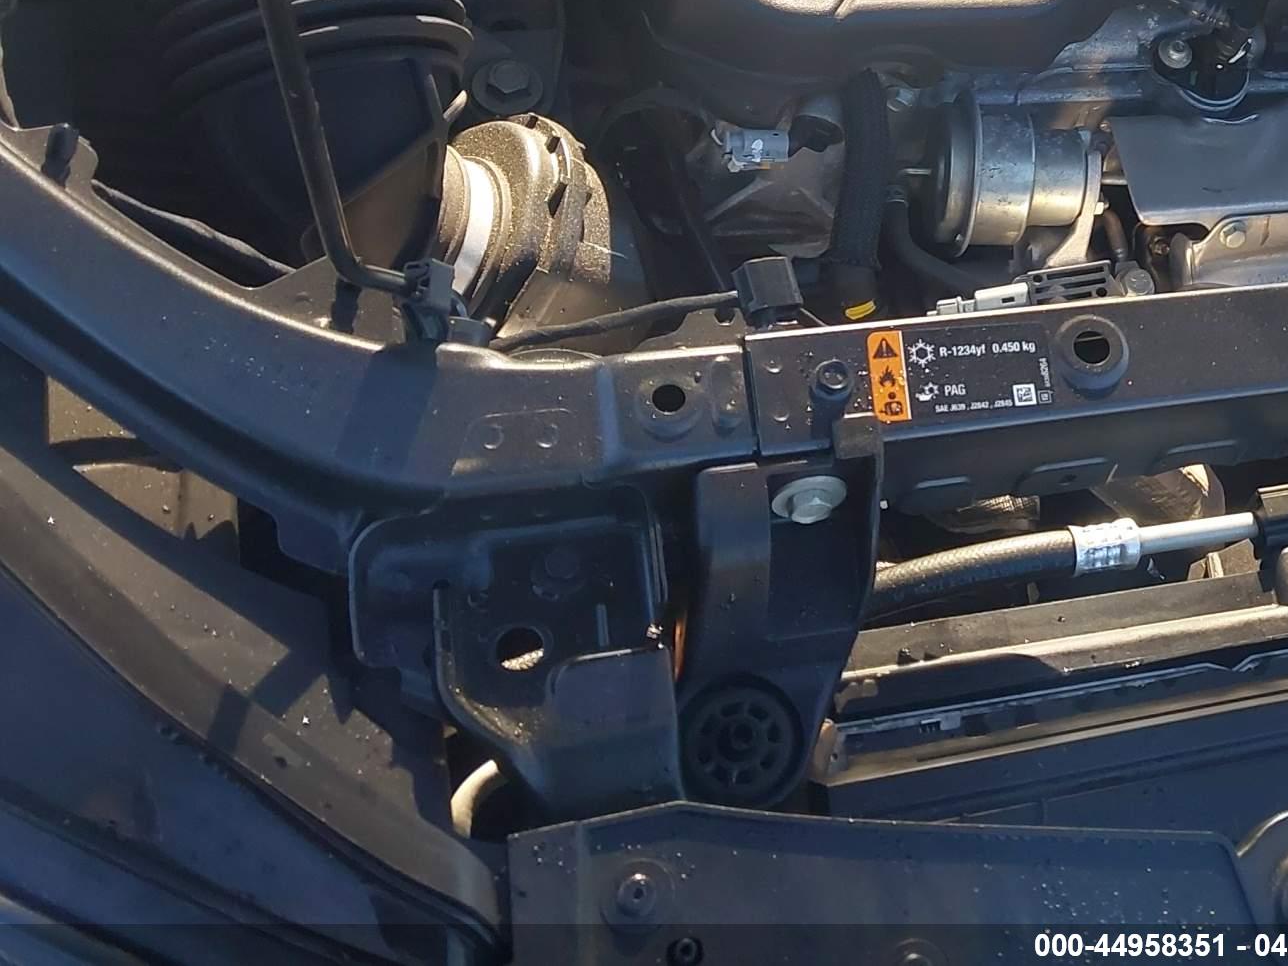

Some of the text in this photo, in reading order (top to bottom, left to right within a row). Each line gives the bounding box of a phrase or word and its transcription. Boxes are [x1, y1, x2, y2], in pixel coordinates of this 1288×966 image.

[939, 340, 1036, 357] R-1234yf 0.450 kg
[944, 384, 966, 396] PAG
